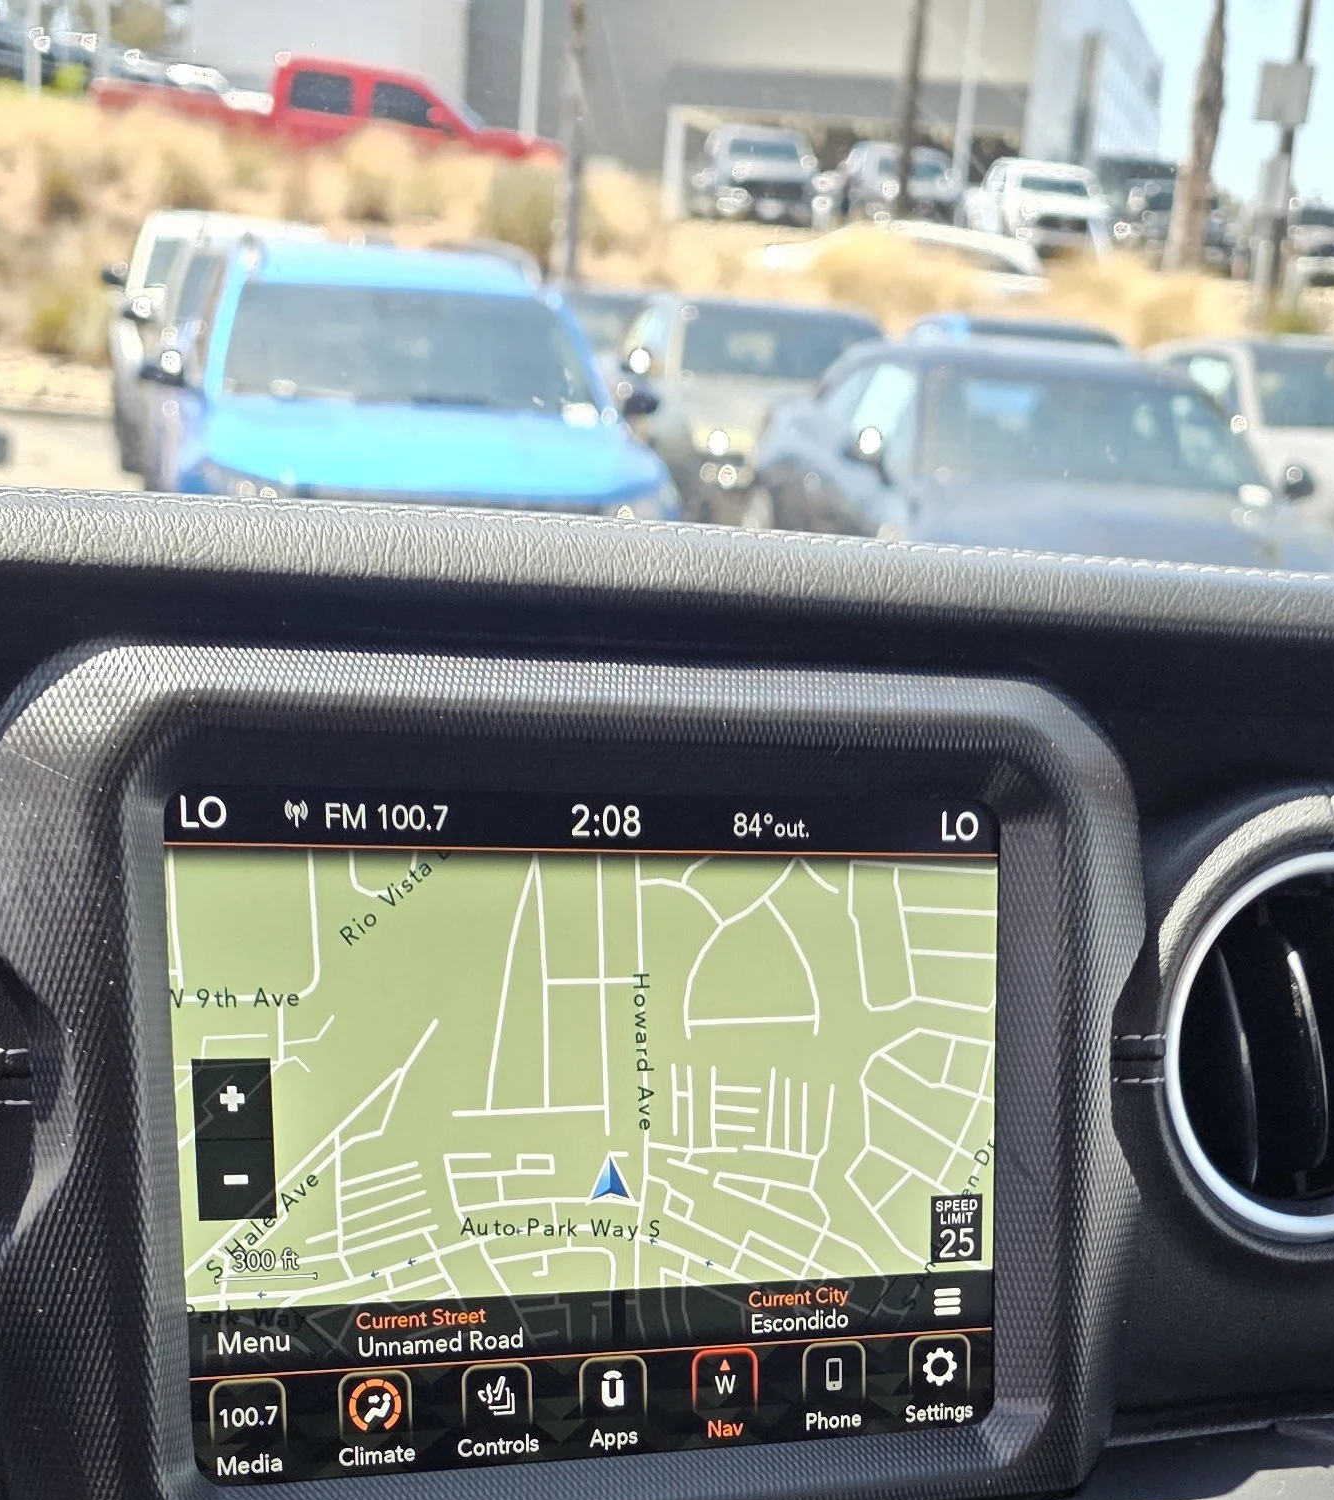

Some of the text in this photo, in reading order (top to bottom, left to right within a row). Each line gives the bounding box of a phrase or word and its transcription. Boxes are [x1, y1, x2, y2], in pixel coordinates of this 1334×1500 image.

[179, 795, 227, 829] LO
[325, 803, 449, 832] FM 100.7
[571, 805, 642, 838] 2:08
[941, 811, 979, 841] LO
[339, 862, 433, 947] Rio Vista
[196, 987, 237, 1009] 9th
[253, 987, 301, 1008] Ave
[633, 973, 655, 1131] Howard Ave
[280, 1174, 319, 1212] Ave
[935, 1199, 978, 1212] SPEED
[460, 1217, 661, 1242] Auto Park Way S
[940, 1212, 974, 1225] LIMIT
[939, 1227, 975, 1259] 25
[232, 1247, 299, 1272] 300 ft
[748, 1287, 849, 1308] Current City
[356, 1308, 487, 1331] Current Street
[751, 1309, 849, 1334] Escondido
[217, 1330, 291, 1356] Menu
[357, 1326, 524, 1358] Unnamed Road
[714, 1374, 736, 1395] W
[218, 1405, 279, 1428] 100.7
[805, 1411, 862, 1431] Phone
[905, 1402, 974, 1424] Settings
[589, 1429, 639, 1451] Apps
[707, 1418, 744, 1438] Nav
[338, 1445, 416, 1467] Climate
[457, 1434, 540, 1458] Controls
[217, 1455, 283, 1476] Media
